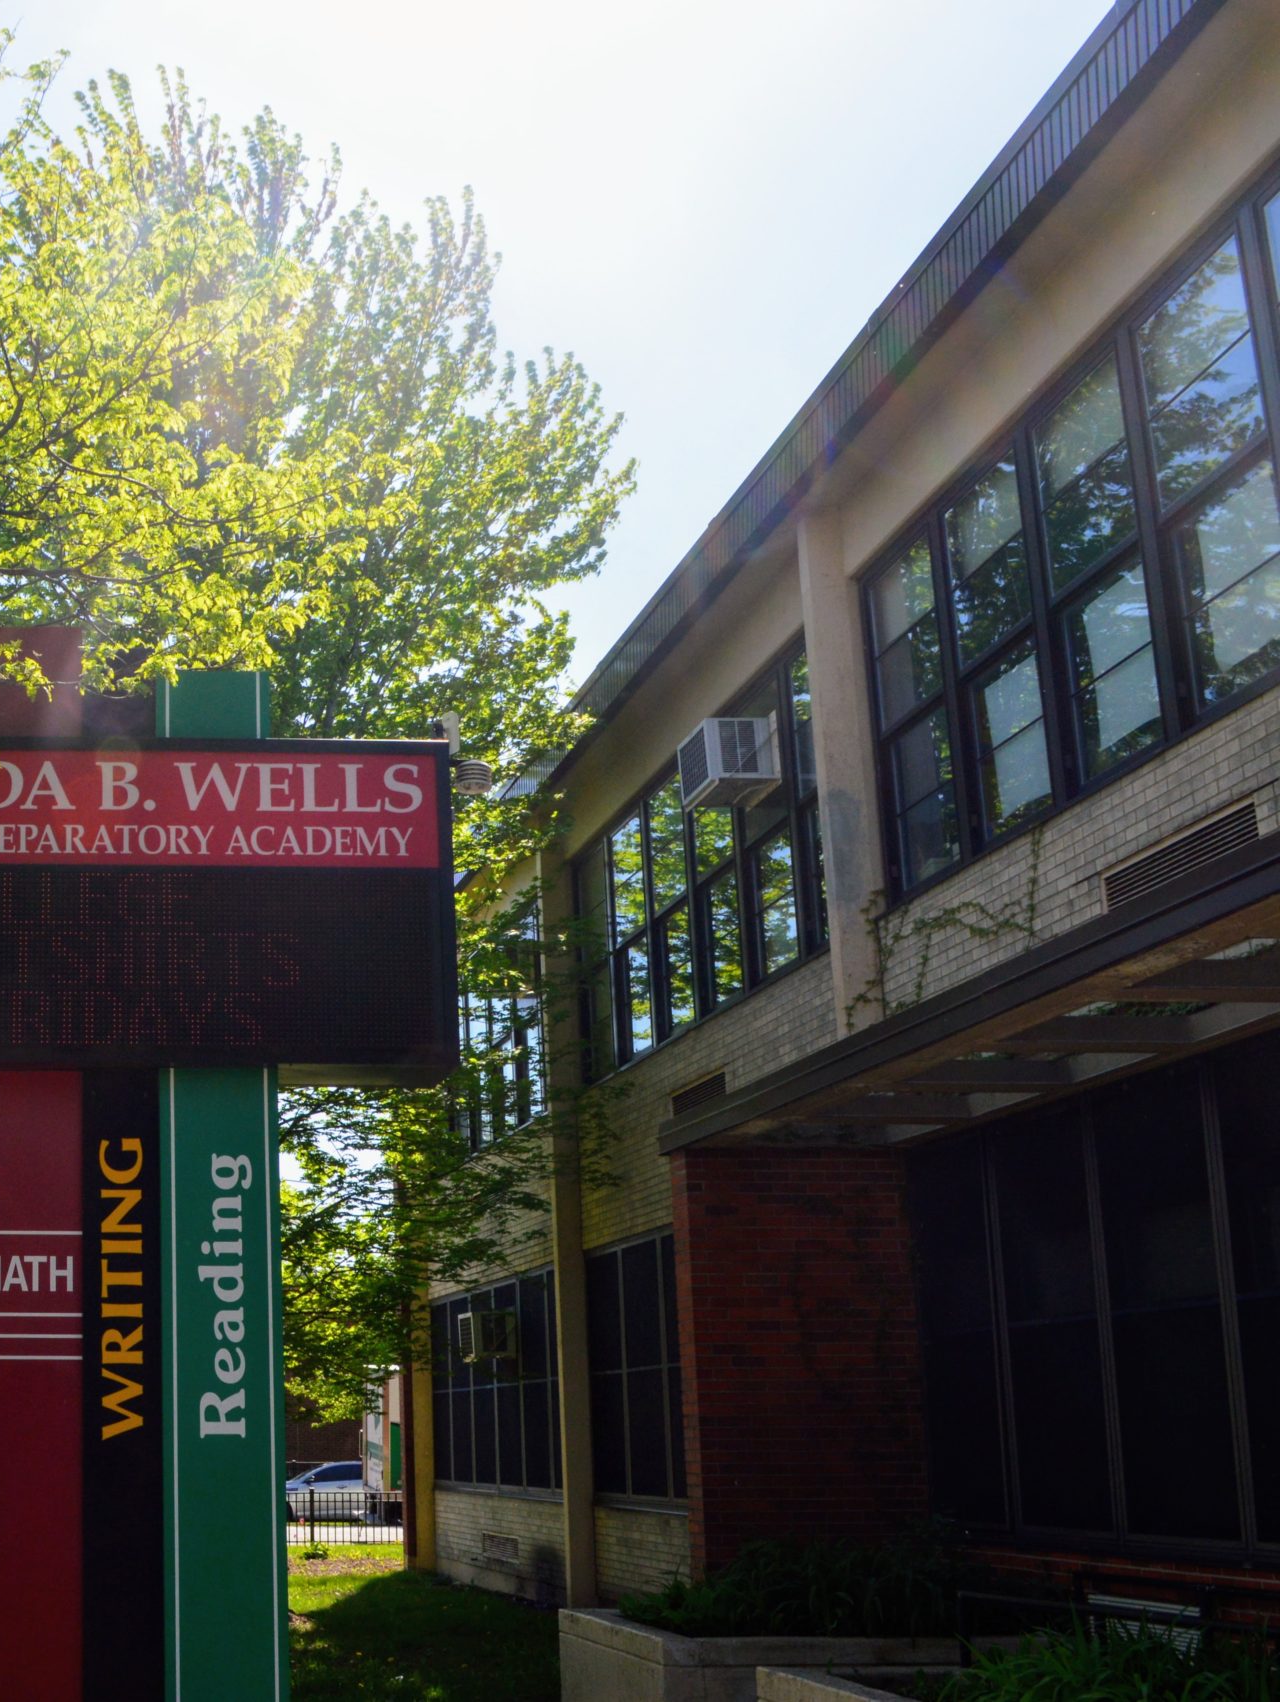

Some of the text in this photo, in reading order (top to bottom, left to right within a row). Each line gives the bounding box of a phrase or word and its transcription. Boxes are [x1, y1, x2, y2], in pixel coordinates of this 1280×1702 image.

[95, 761, 156, 811] B.
[173, 762, 423, 813] WELLS
[225, 825, 413, 856] ACADEMY
[99, 1136, 144, 1441] WRITING
[198, 1153, 253, 1439] Reading
